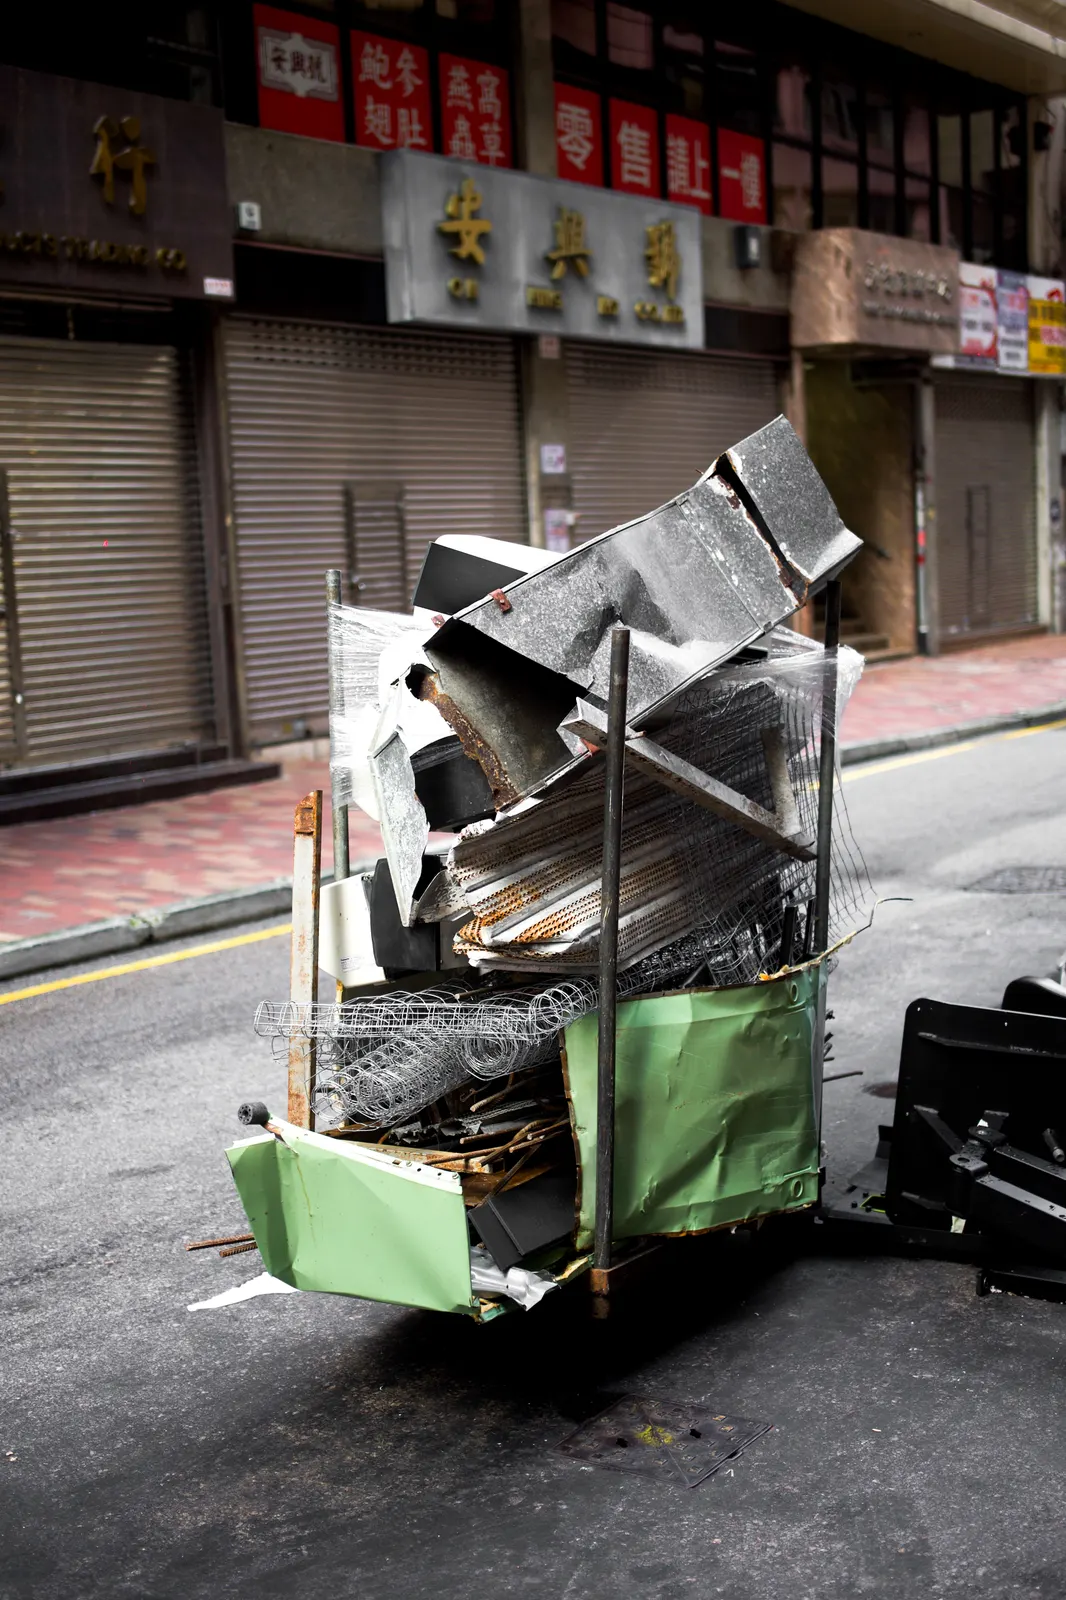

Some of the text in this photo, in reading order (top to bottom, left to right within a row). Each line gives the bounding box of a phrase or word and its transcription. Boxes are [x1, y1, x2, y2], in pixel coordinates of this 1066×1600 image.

[271, 46, 326, 84] 安興號
[90, 115, 157, 215] 行
[438, 177, 681, 299] 安興號
